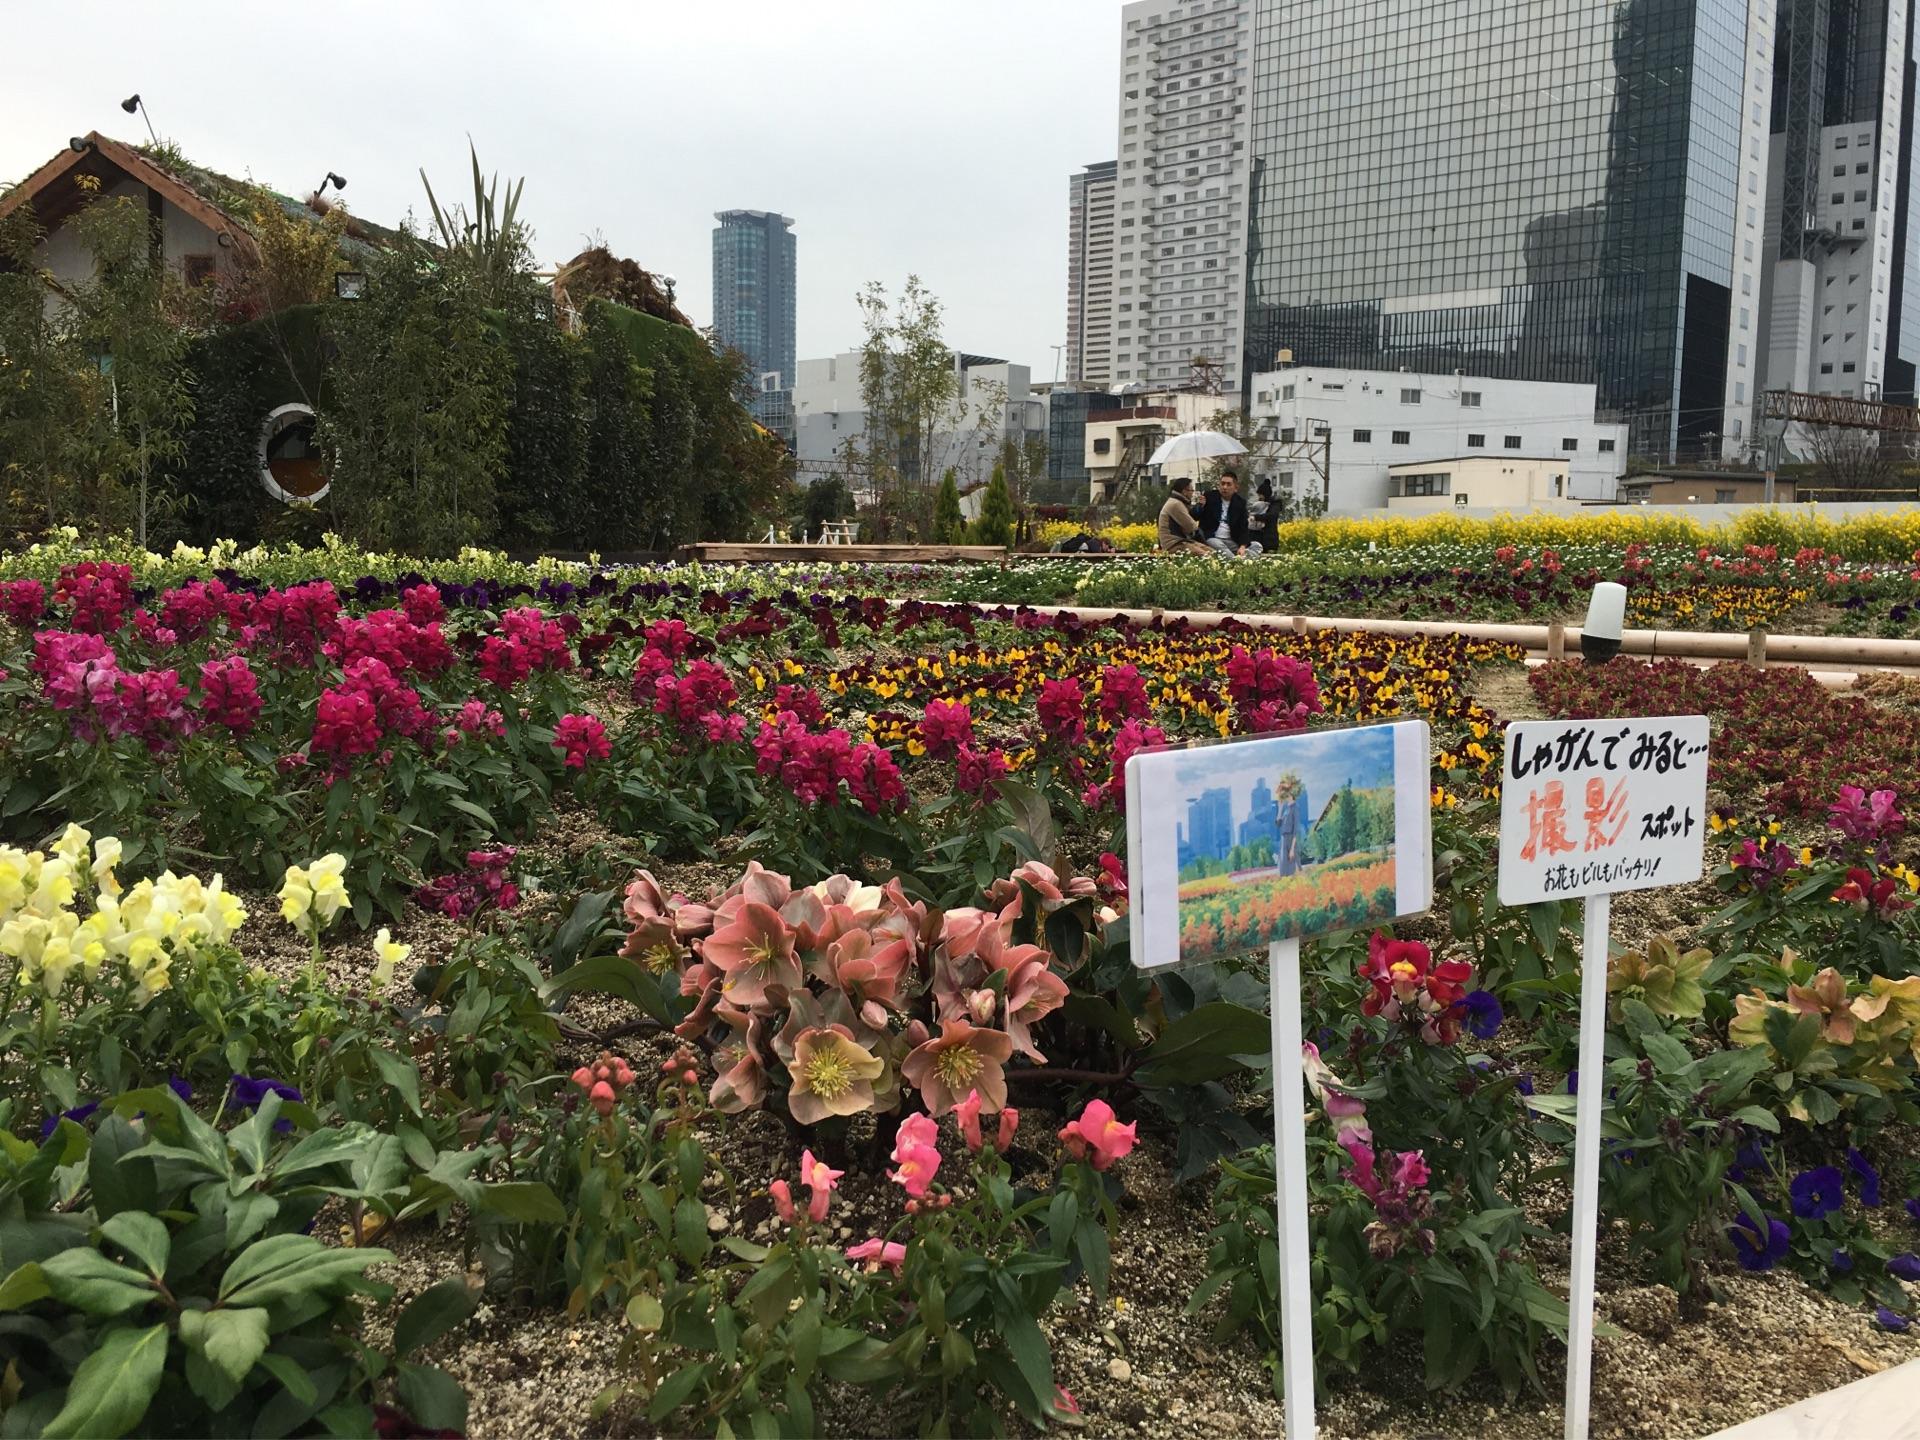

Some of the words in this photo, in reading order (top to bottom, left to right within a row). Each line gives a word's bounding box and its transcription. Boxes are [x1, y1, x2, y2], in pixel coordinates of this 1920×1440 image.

[1520, 775, 1629, 862] 撮影
[1640, 805, 1695, 841] スポット
